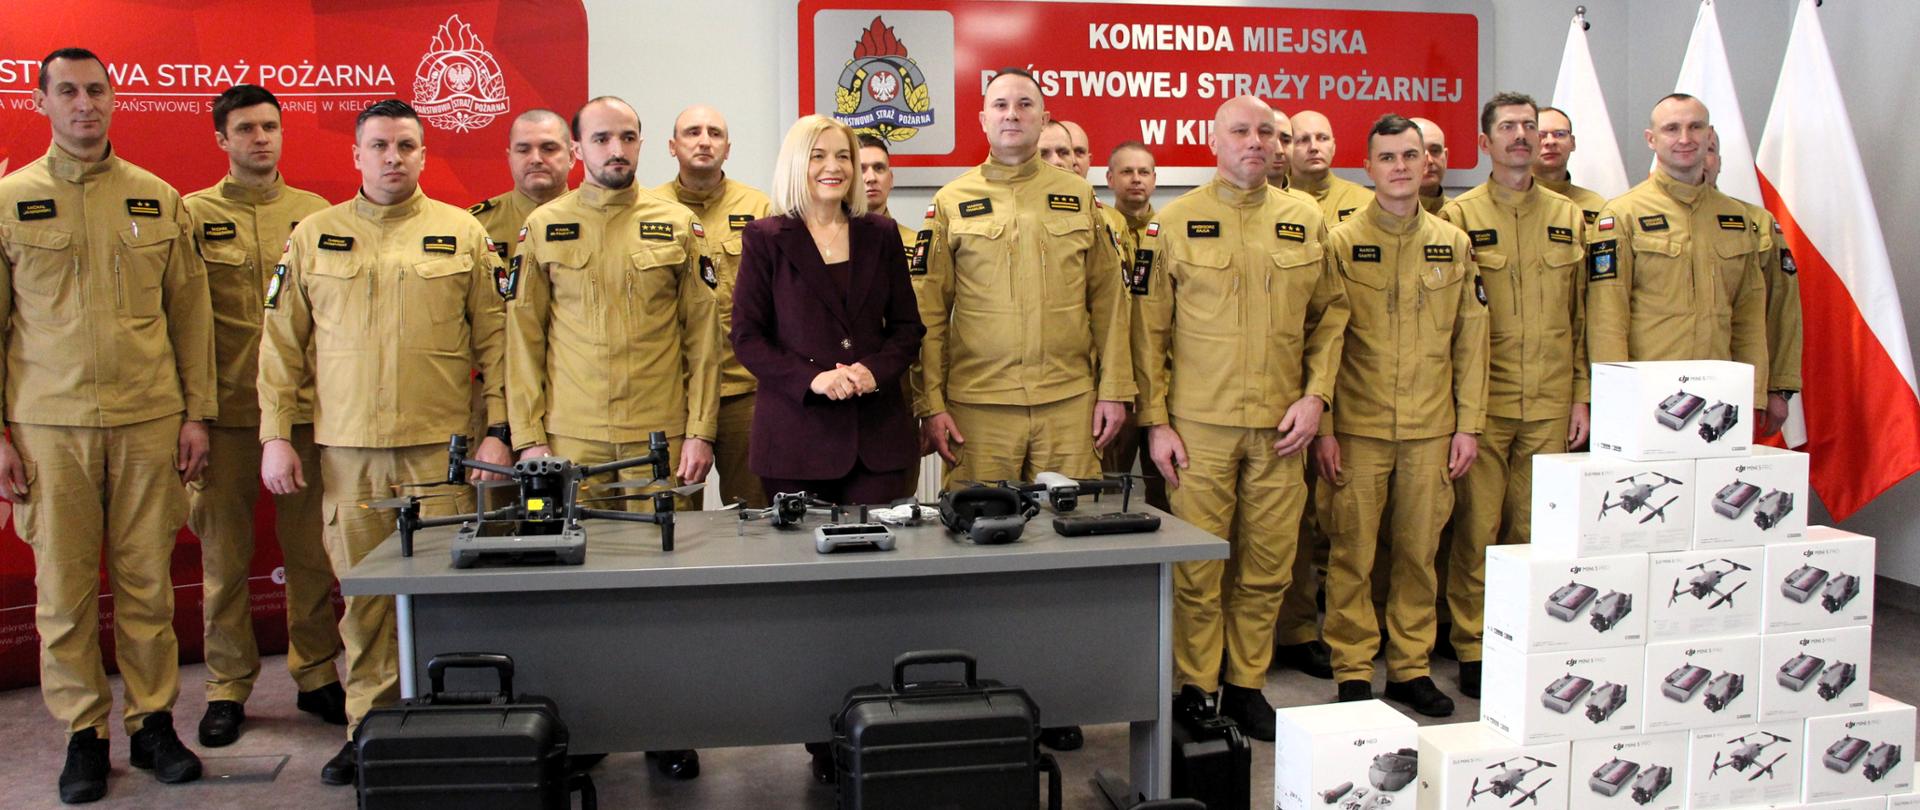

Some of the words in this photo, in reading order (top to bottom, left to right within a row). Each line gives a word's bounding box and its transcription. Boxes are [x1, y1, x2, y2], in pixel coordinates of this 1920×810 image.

[1089, 23, 1234, 52] KOMENDA
[1243, 26, 1367, 54] MIEJSKA
[0, 59, 149, 86] STWA
[158, 60, 250, 87] STRAŻ
[260, 60, 395, 87] POŻARNA
[981, 63, 1188, 98] PSTWOWEJ
[1197, 68, 1309, 99] STRAŻY
[1320, 68, 1463, 102] POŻARNEJ
[114, 98, 200, 114] PAŃSTWOWEJ
[279, 101, 317, 114] ARNEJ
[321, 101, 334, 111] W
[339, 100, 377, 111] KIELC
[876, 109, 895, 119] STRAŻ
[898, 114, 931, 124] POŻARNA
[1140, 119, 1167, 145] W
